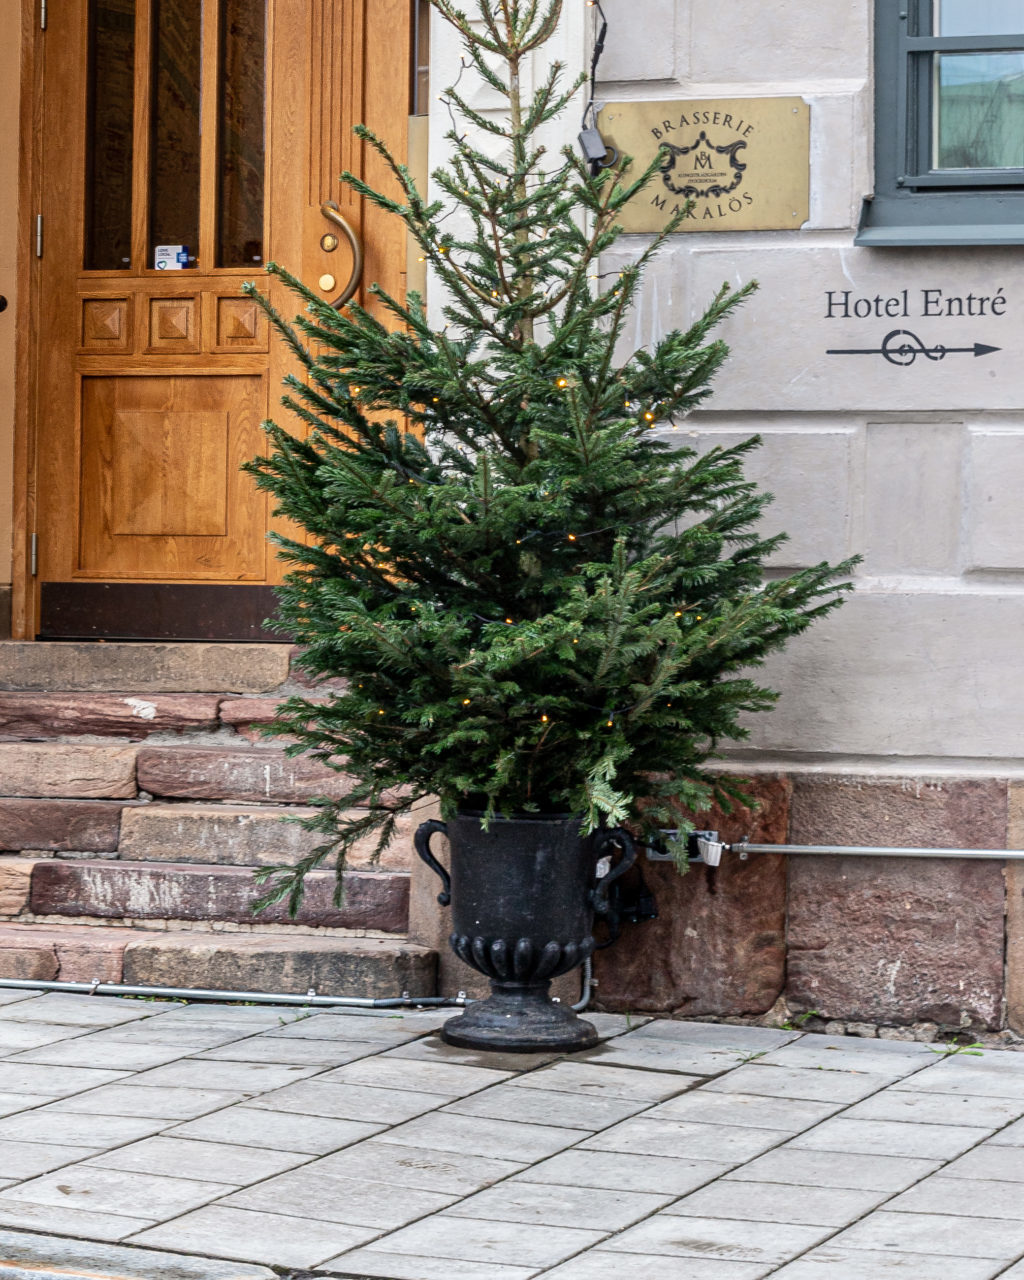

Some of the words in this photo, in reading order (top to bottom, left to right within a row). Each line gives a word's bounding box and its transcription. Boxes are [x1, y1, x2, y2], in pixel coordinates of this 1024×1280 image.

[651, 111, 754, 140] BRASSERIE
[824, 289, 910, 318] Hotel
[920, 287, 1007, 317] Entré
